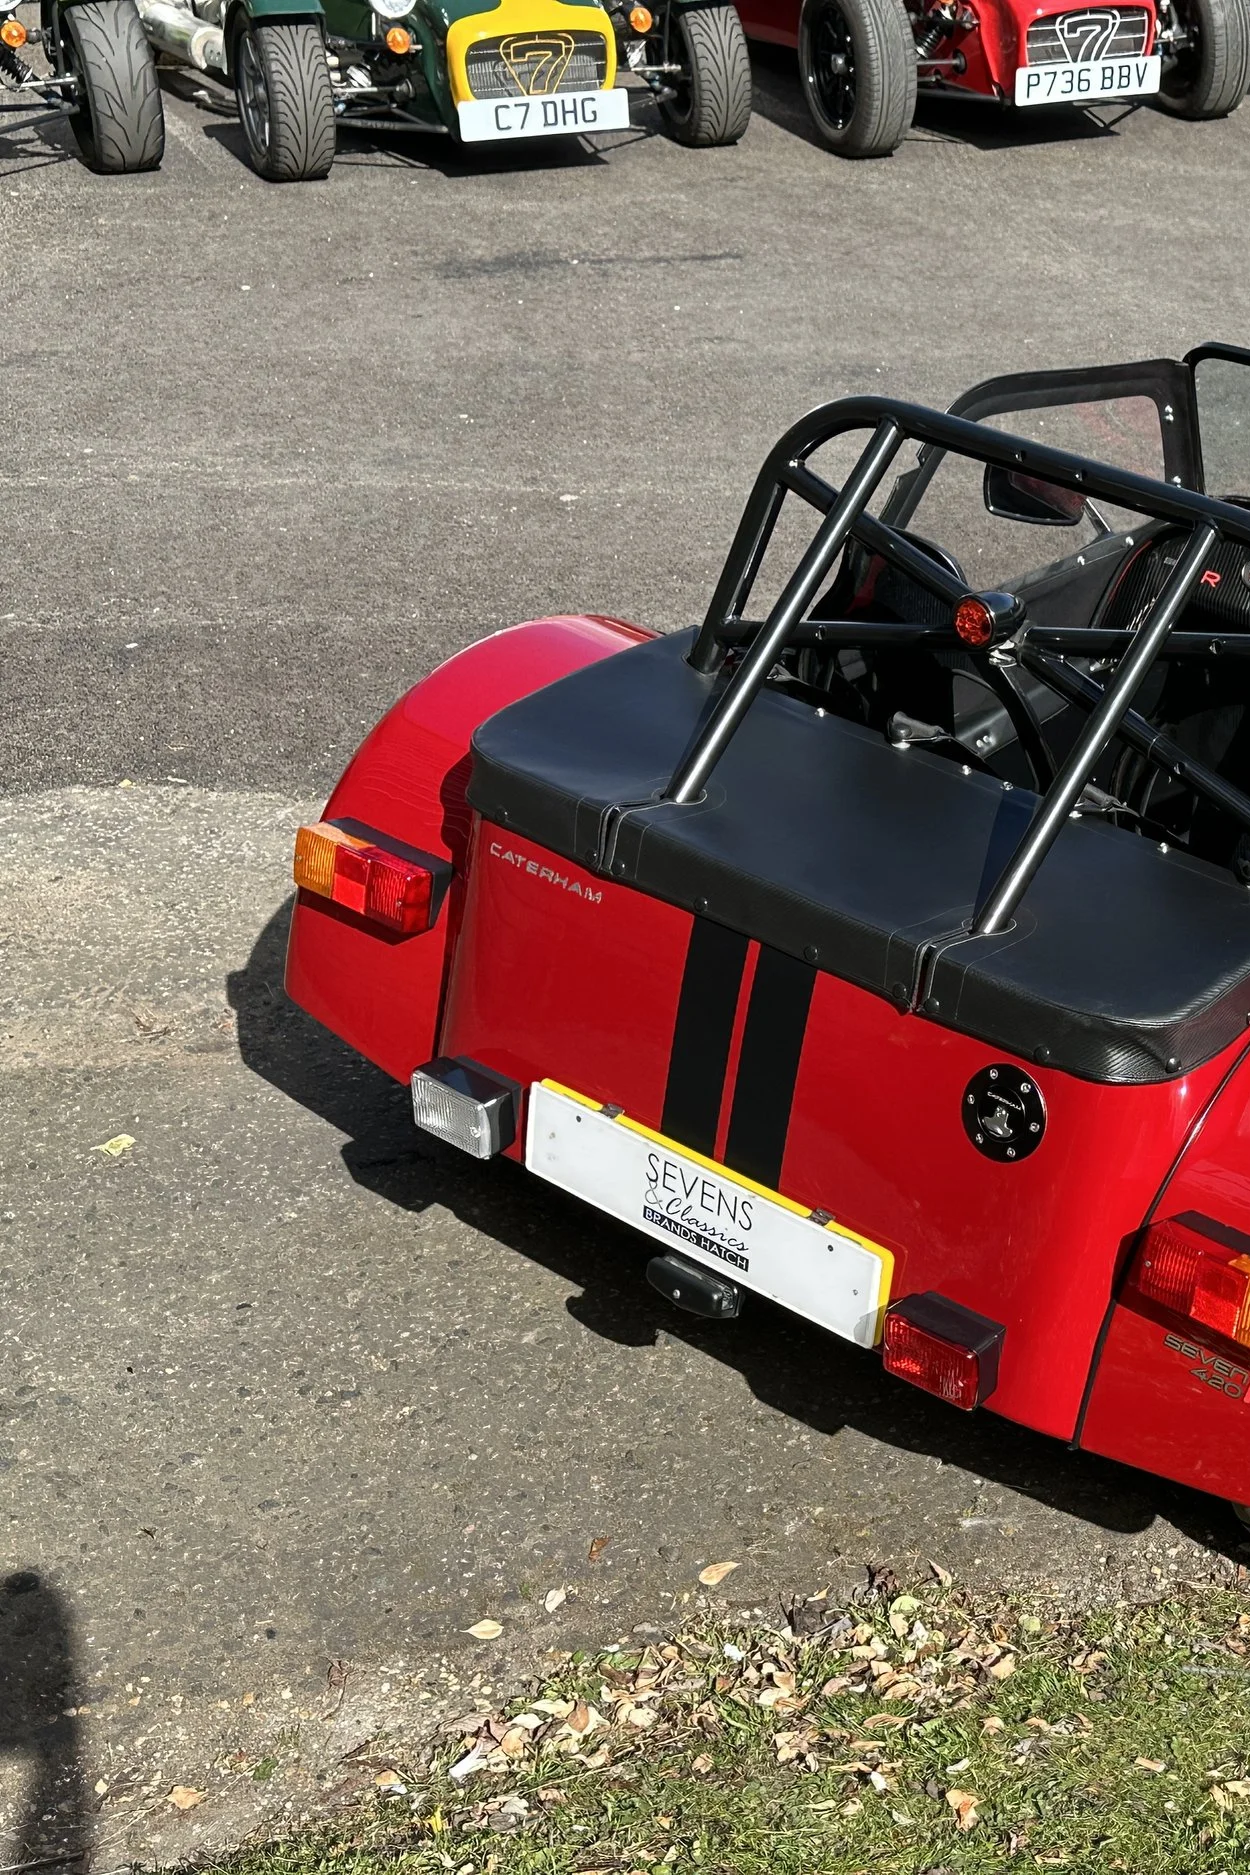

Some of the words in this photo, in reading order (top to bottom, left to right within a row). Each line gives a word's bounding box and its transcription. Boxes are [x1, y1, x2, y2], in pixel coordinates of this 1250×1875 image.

[1064, 13, 1113, 62] 7
[510, 39, 565, 95] 7
[1026, 68, 1091, 99] P736
[1100, 62, 1148, 90] BBV
[494, 102, 530, 131] C7
[541, 97, 598, 128] DHG
[1200, 570, 1221, 587] R
[489, 841, 603, 904] CATERHAM
[646, 1152, 753, 1231] SEVENS
[645, 1208, 698, 1244] BRANDS
[700, 1237, 747, 1270] HATCH
[665, 1197, 749, 1252] Classics
[1163, 1333, 1249, 1385] SEVEN
[1190, 1367, 1244, 1399] 420
